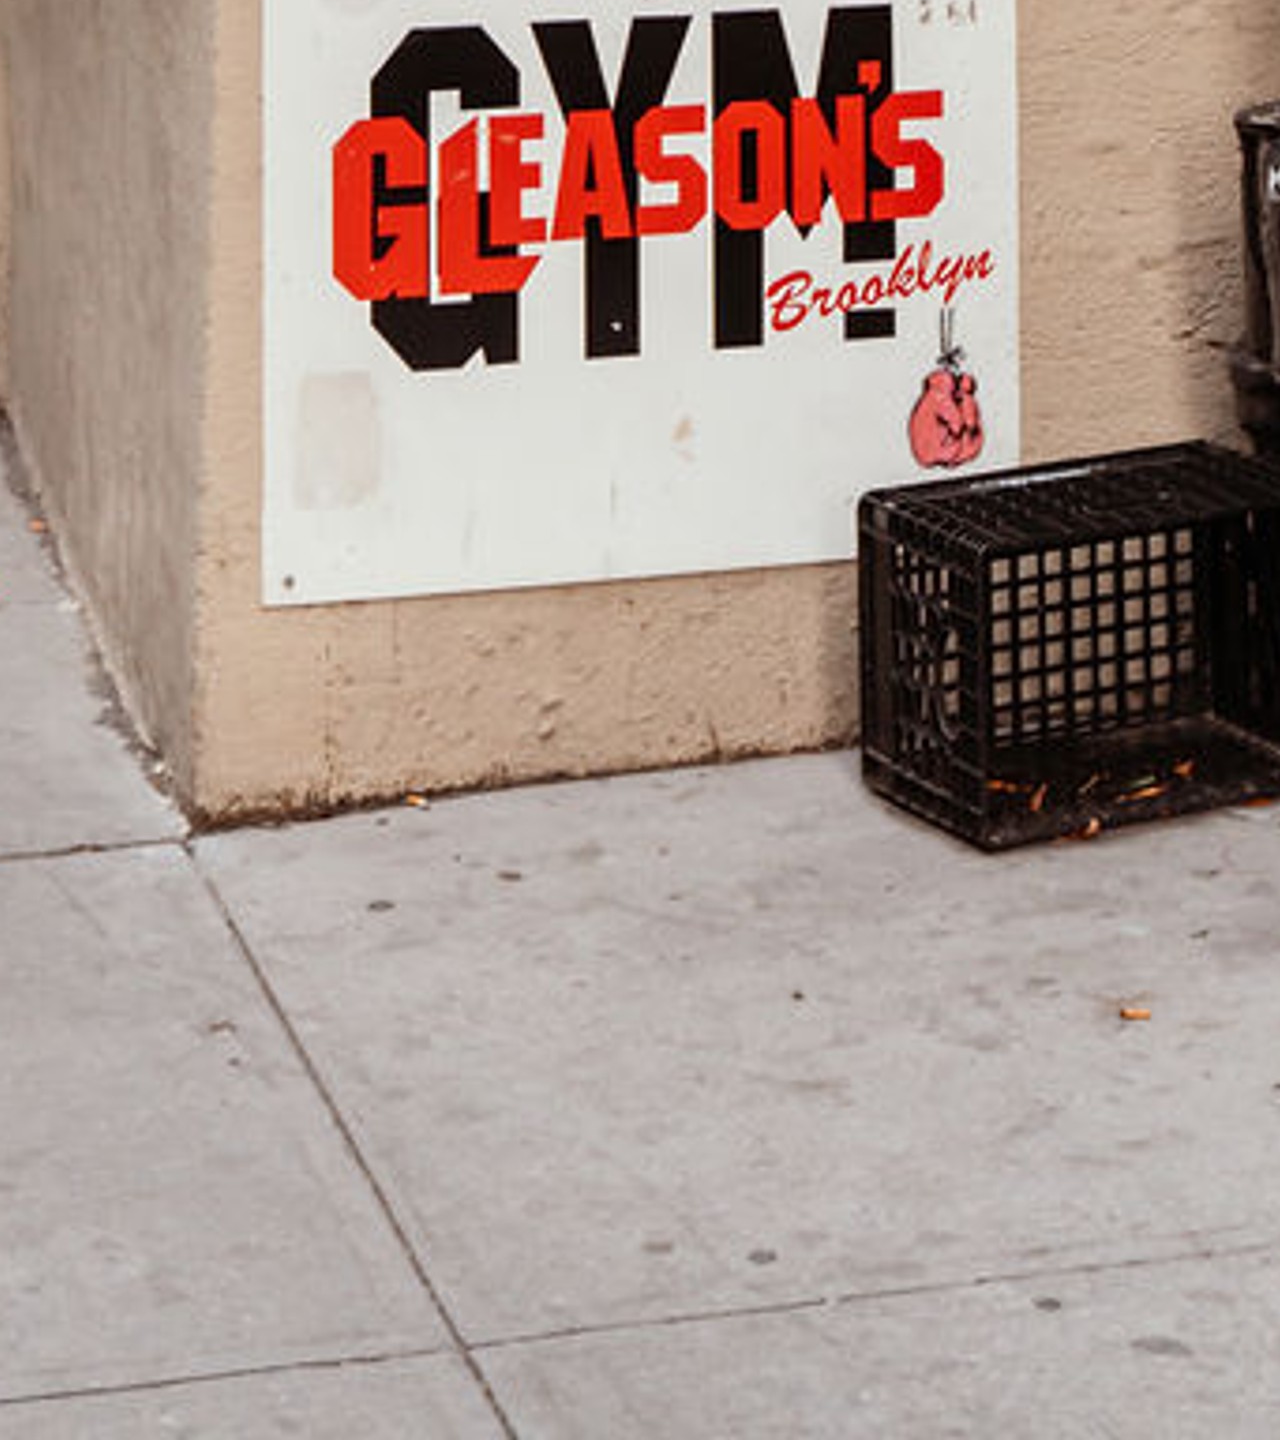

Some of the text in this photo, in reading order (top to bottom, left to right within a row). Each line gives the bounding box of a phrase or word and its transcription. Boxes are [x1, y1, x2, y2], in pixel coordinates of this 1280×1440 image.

[331, 61, 945, 302] GLEASON'S
[370, 3, 897, 372] GYM
[766, 241, 997, 332] Brooklyn
